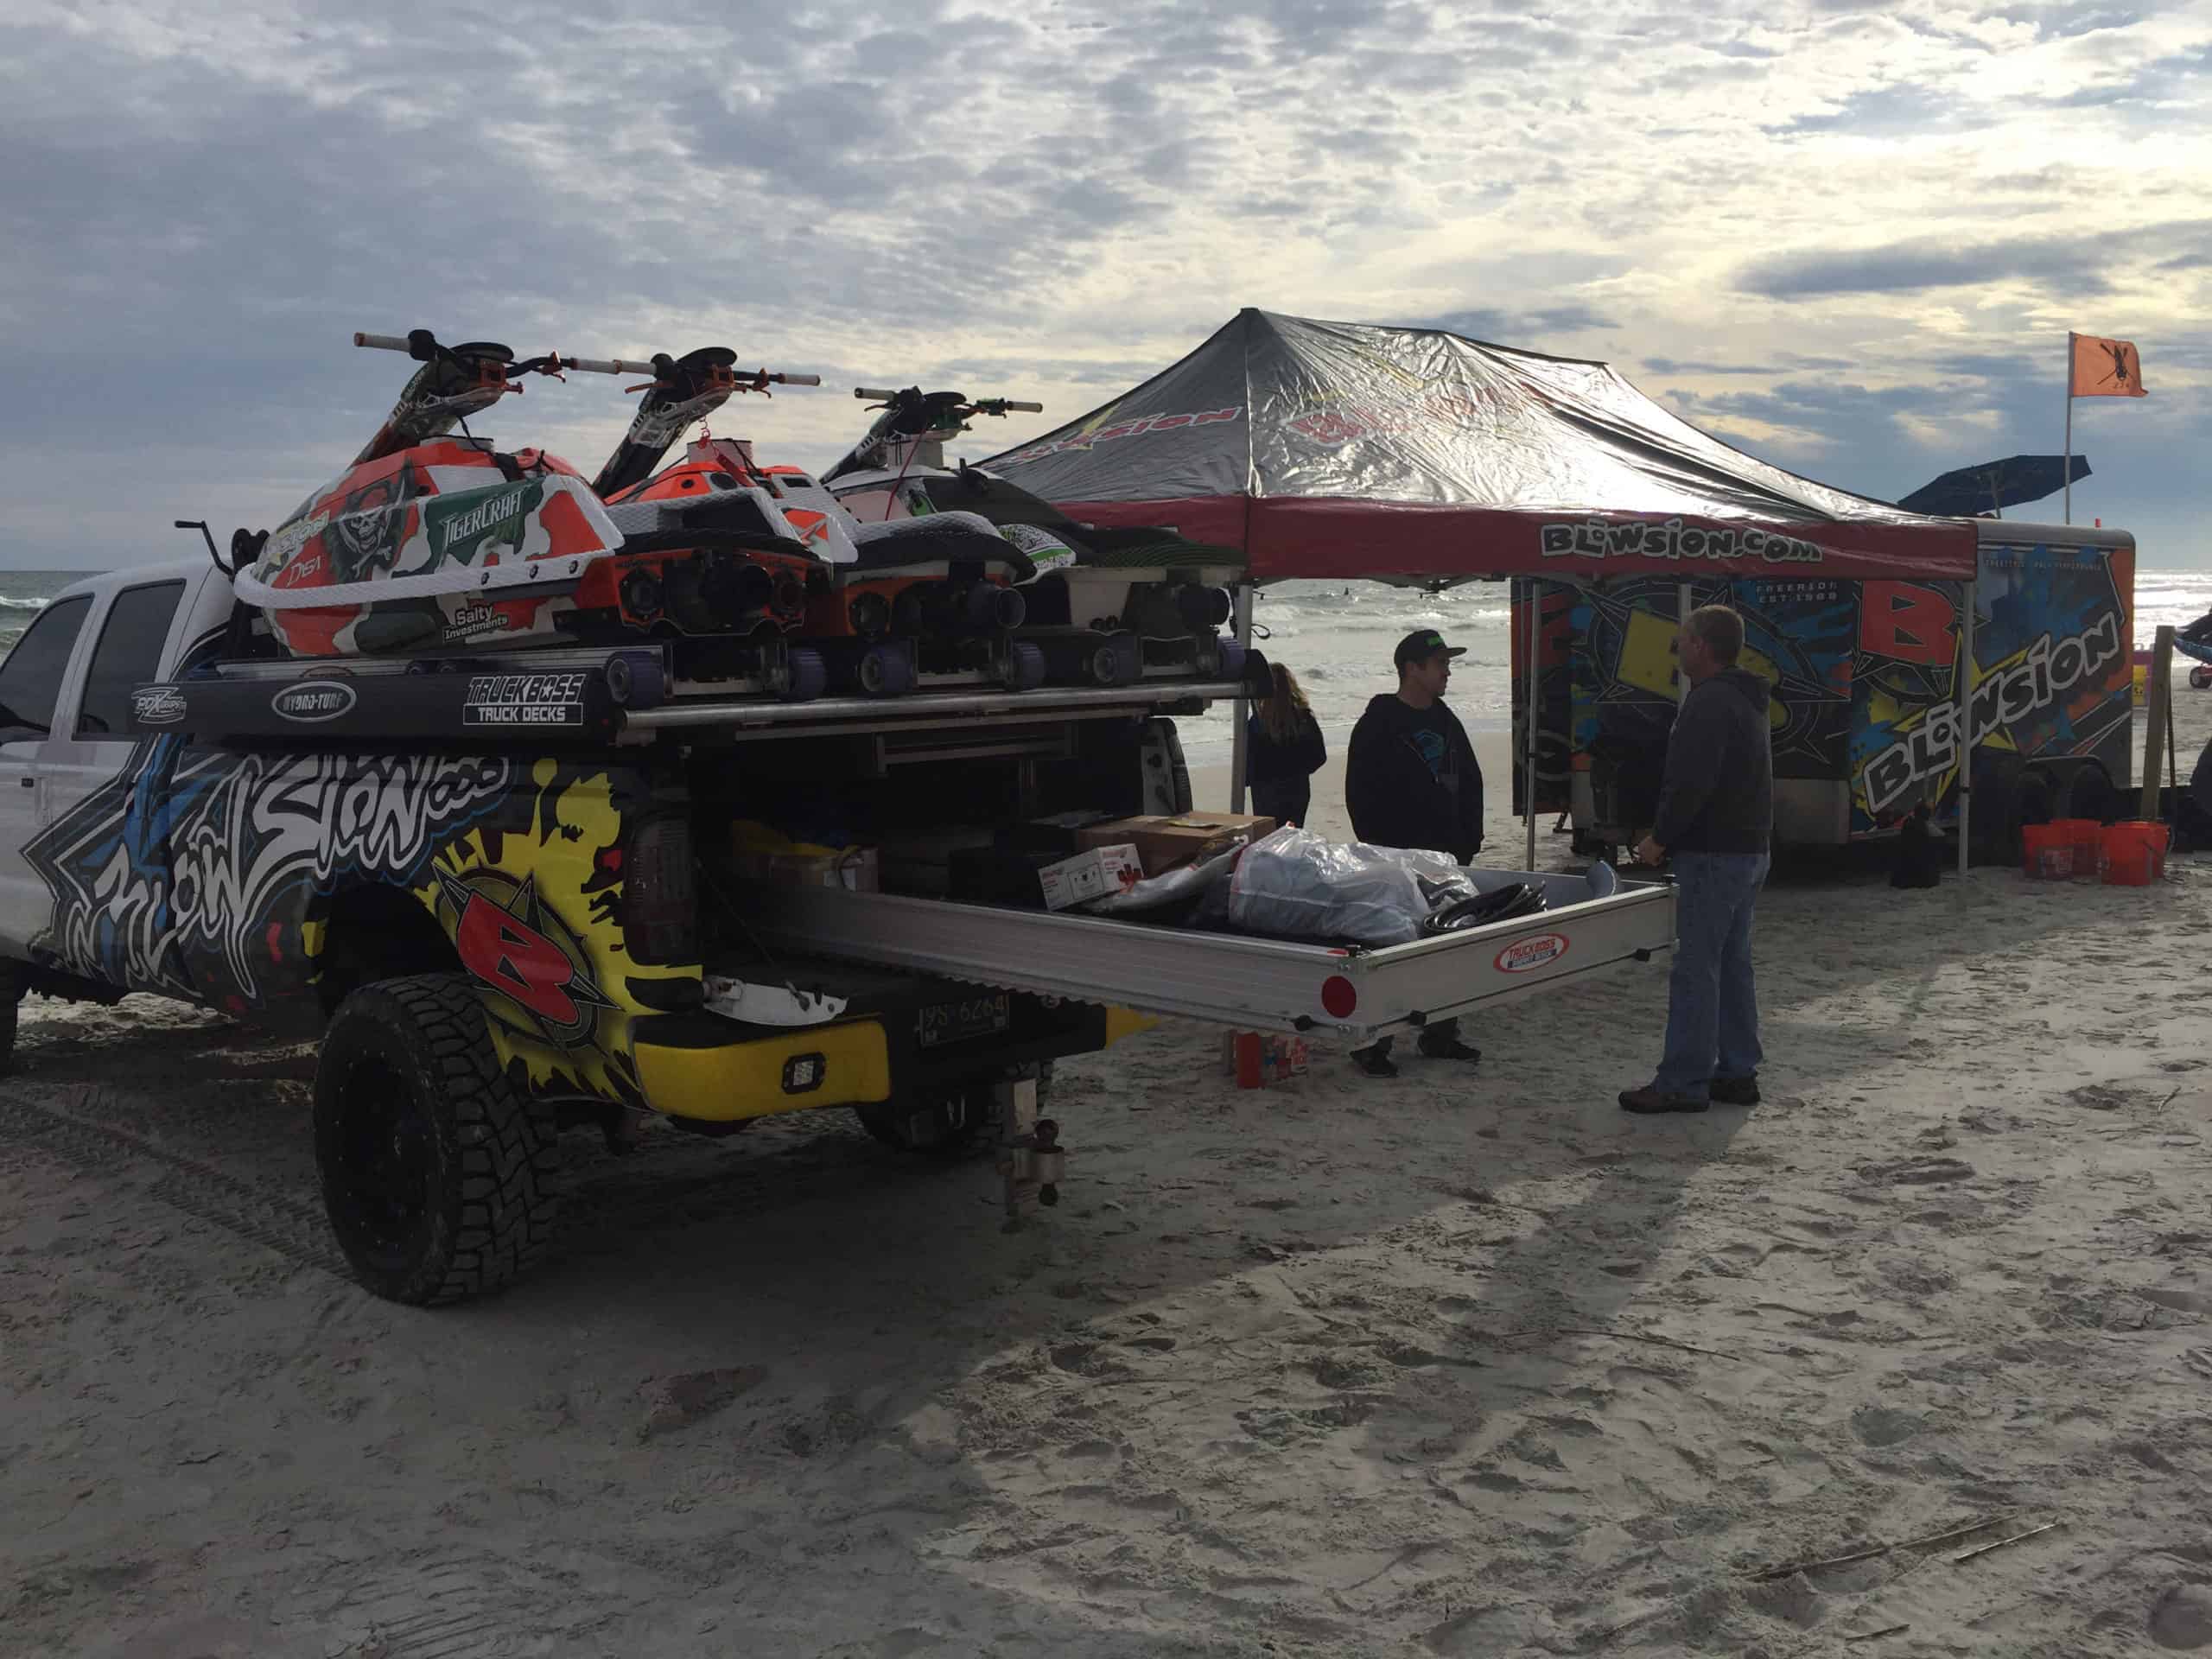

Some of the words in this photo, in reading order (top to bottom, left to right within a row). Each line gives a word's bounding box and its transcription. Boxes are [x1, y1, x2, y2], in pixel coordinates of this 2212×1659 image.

[455, 605, 493, 626] Salty
[444, 616, 508, 639] Investments
[283, 692, 344, 711] HYDRO-TURF
[478, 707, 518, 722] TRUCK
[522, 707, 566, 722] DECKS
